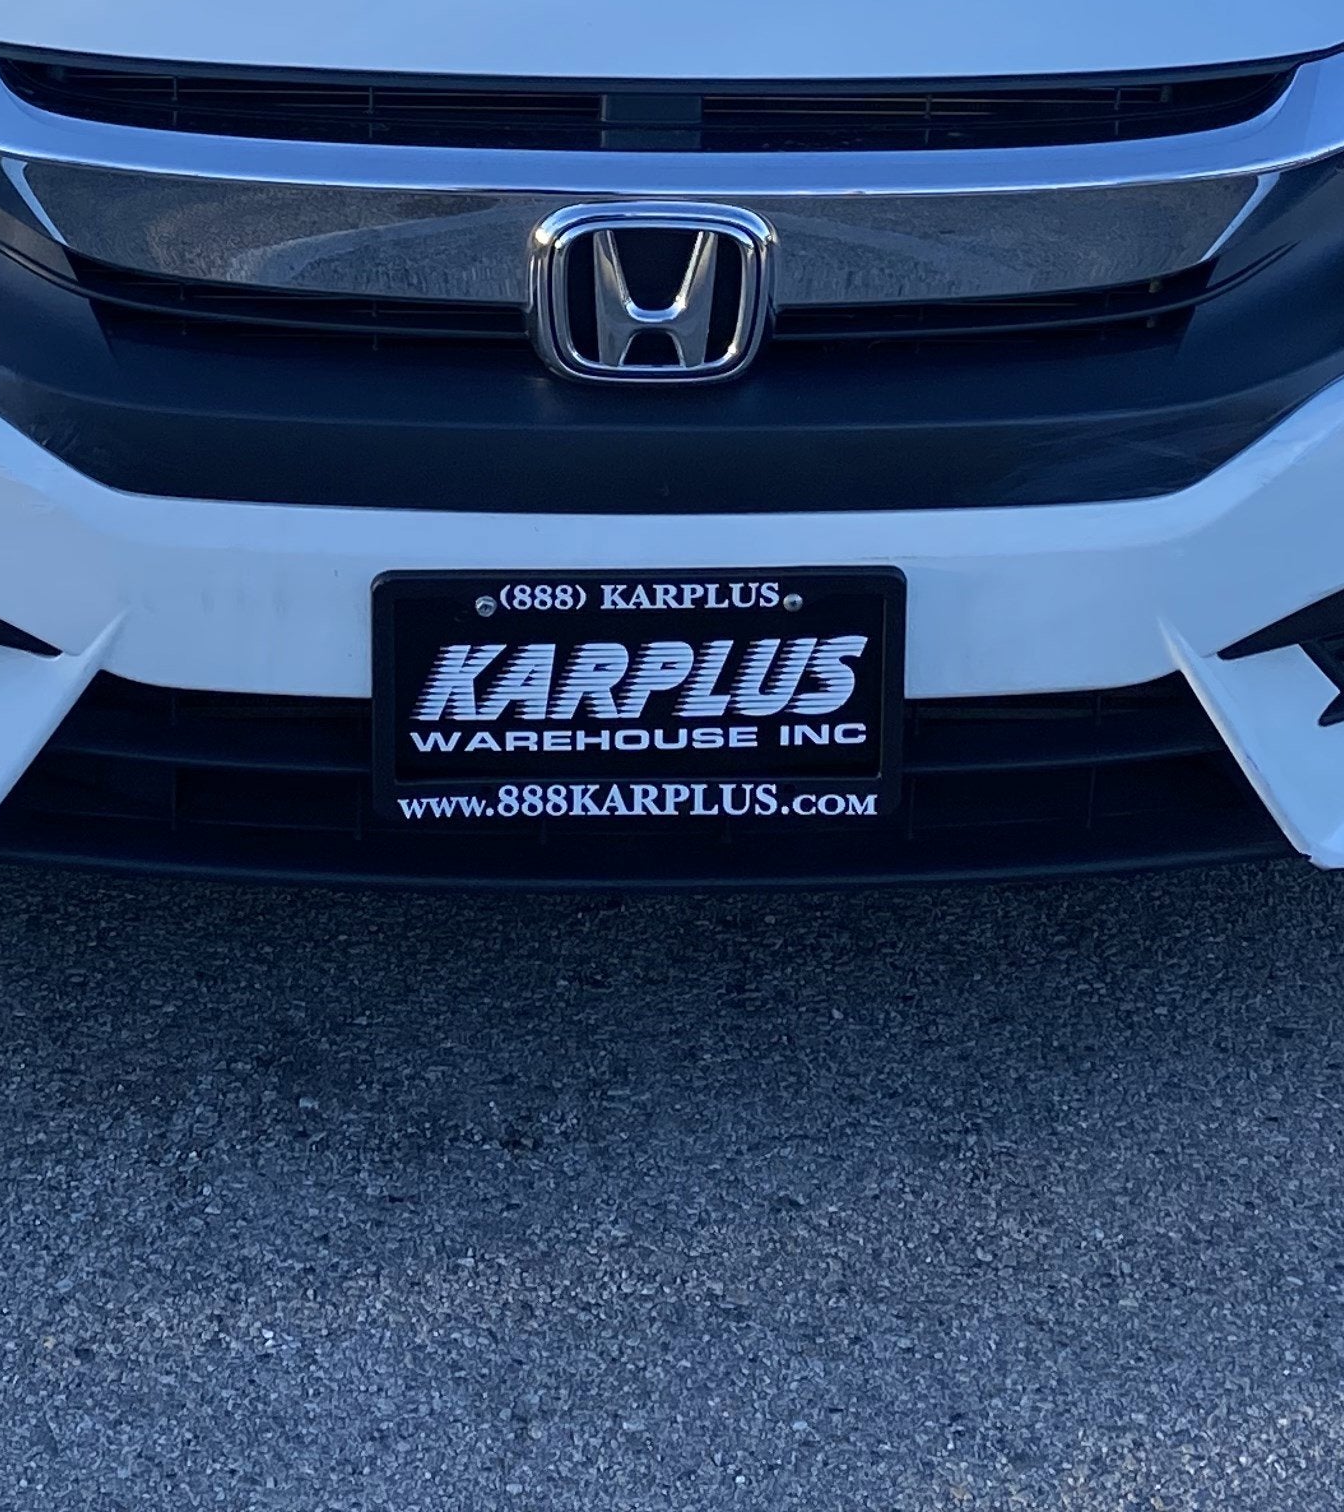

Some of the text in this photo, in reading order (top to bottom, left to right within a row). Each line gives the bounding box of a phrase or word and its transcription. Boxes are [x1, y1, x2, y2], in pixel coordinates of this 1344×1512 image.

[499, 582, 780, 611] (888) KARPLUS
[408, 634, 869, 722] KARPLUS
[409, 722, 867, 752] WAREHOUSE INC
